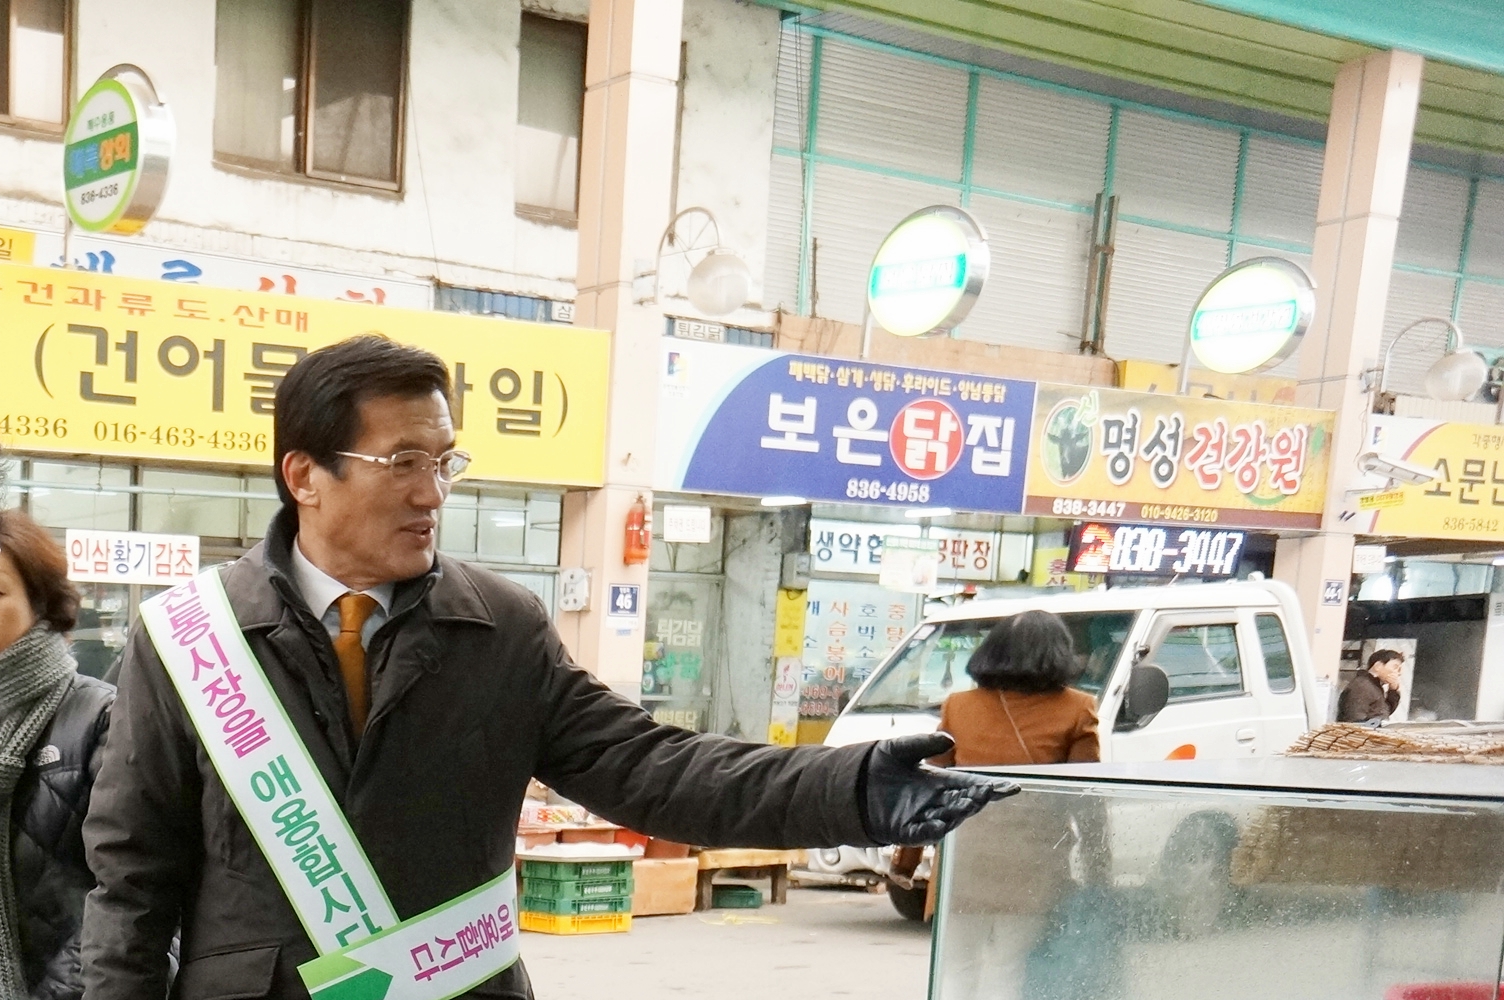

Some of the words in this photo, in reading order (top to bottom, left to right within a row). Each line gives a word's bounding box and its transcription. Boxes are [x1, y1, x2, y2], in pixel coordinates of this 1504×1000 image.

[93, 419, 268, 453] 016-463-4336
[760, 392, 1015, 478] 보은닭집
[1052, 499, 1126, 518] 838-3447
[1442, 516, 1500, 533] 836-5842
[615, 593, 633, 610] 46
[158, 579, 273, 760] 전통시장을
[409, 903, 514, 982] 애용합시다
